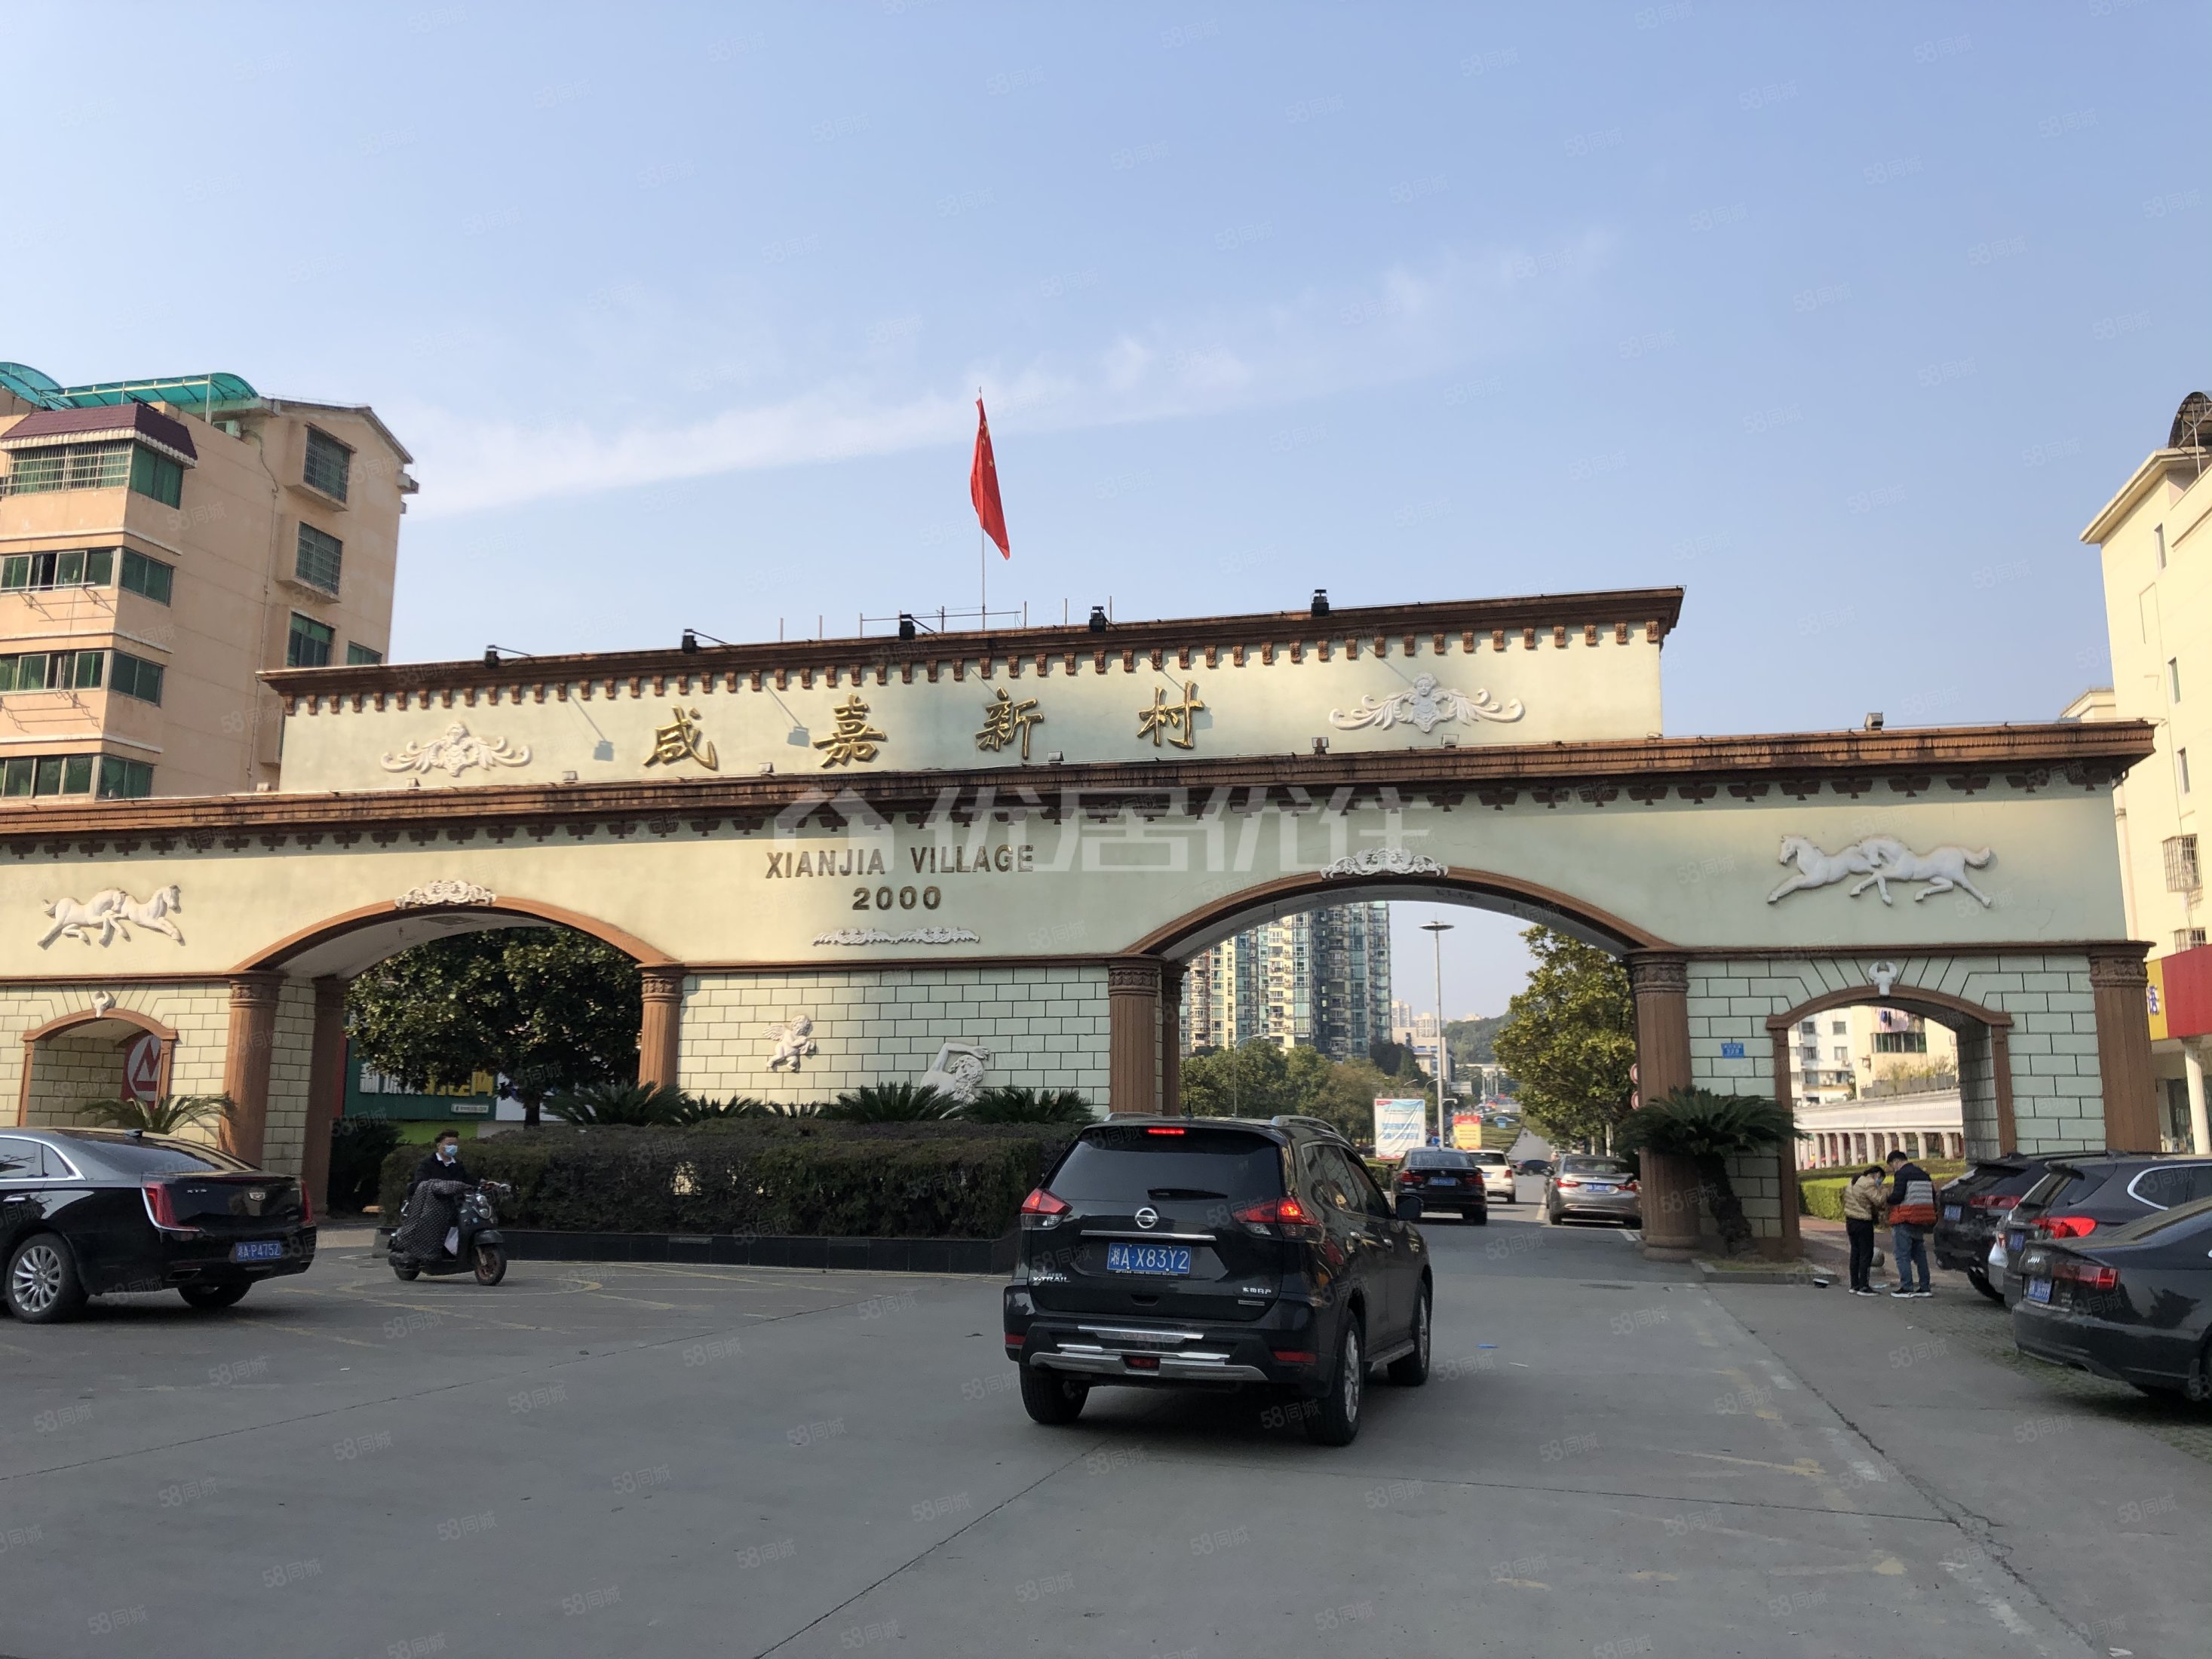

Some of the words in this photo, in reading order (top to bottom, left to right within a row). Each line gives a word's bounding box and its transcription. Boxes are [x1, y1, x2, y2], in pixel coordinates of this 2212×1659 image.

[643, 679, 1204, 771] 咸嘉新村
[765, 847, 886, 879] XIANJIA
[910, 843, 1034, 875] VILLAGE
[851, 885, 942, 911] 2000
